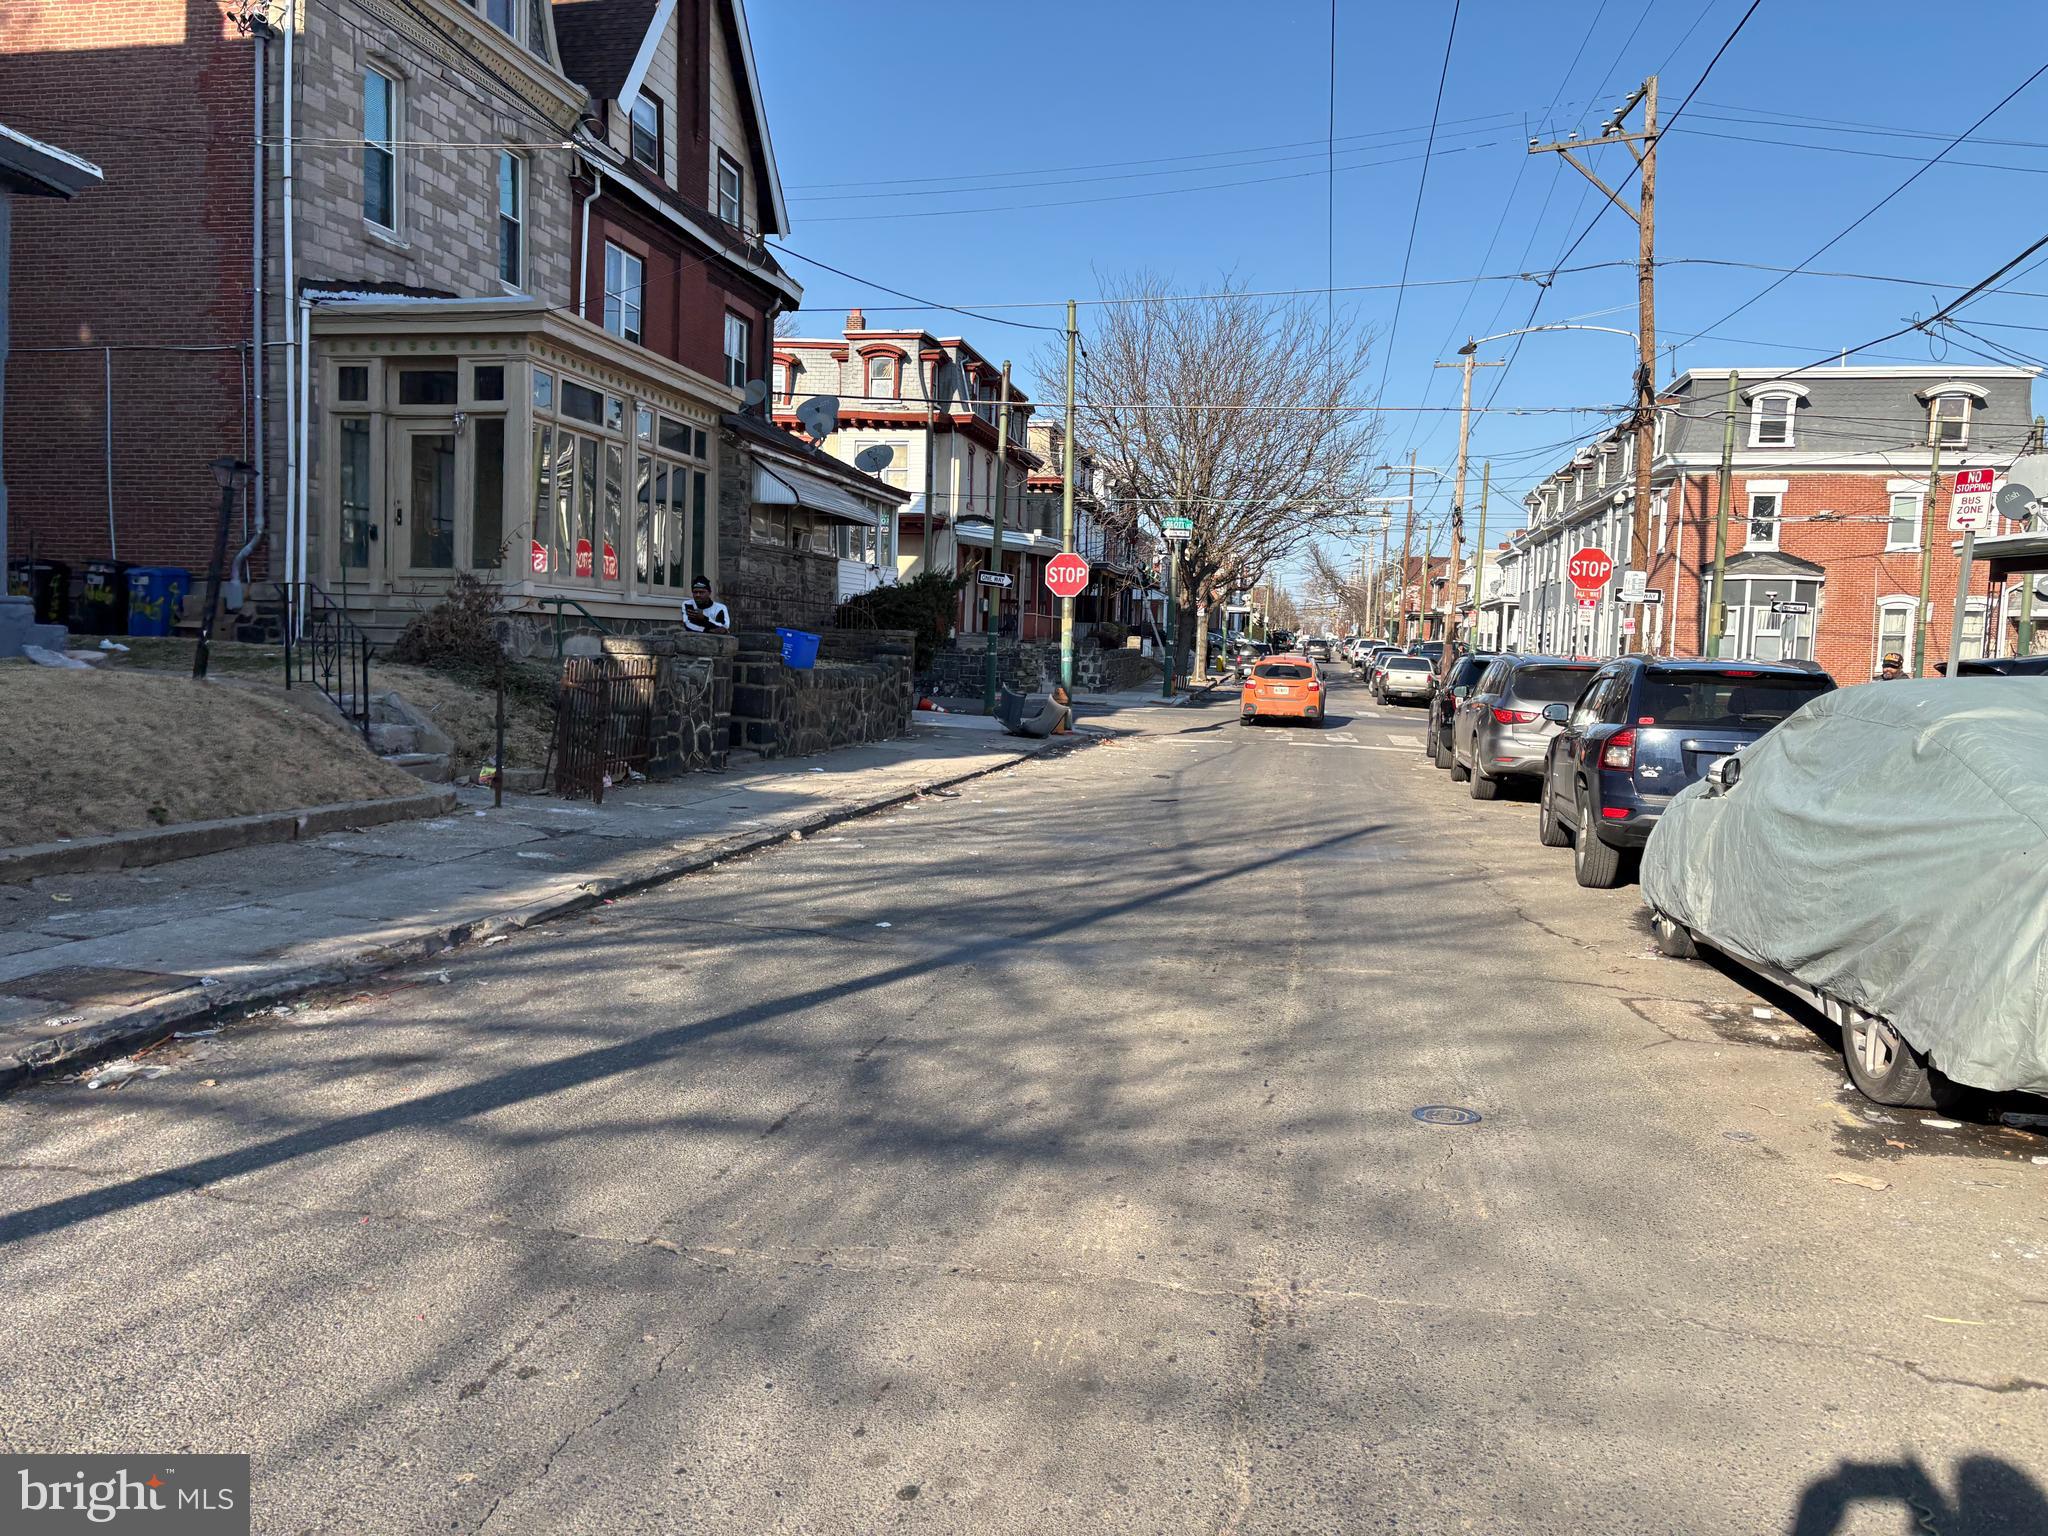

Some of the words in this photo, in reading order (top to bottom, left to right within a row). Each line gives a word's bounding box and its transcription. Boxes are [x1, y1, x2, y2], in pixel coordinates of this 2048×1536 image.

[1967, 471, 1982, 483] NO
[1956, 482, 1992, 493] STOPPING
[1961, 496, 1982, 505] BUS
[2004, 491, 2021, 504] dish
[1956, 505, 1984, 515] ZONE
[1571, 560, 1610, 577] STOP
[981, 574, 992, 582] ONE
[993, 575, 1004, 583] WAY
[1048, 566, 1086, 583] STOP
